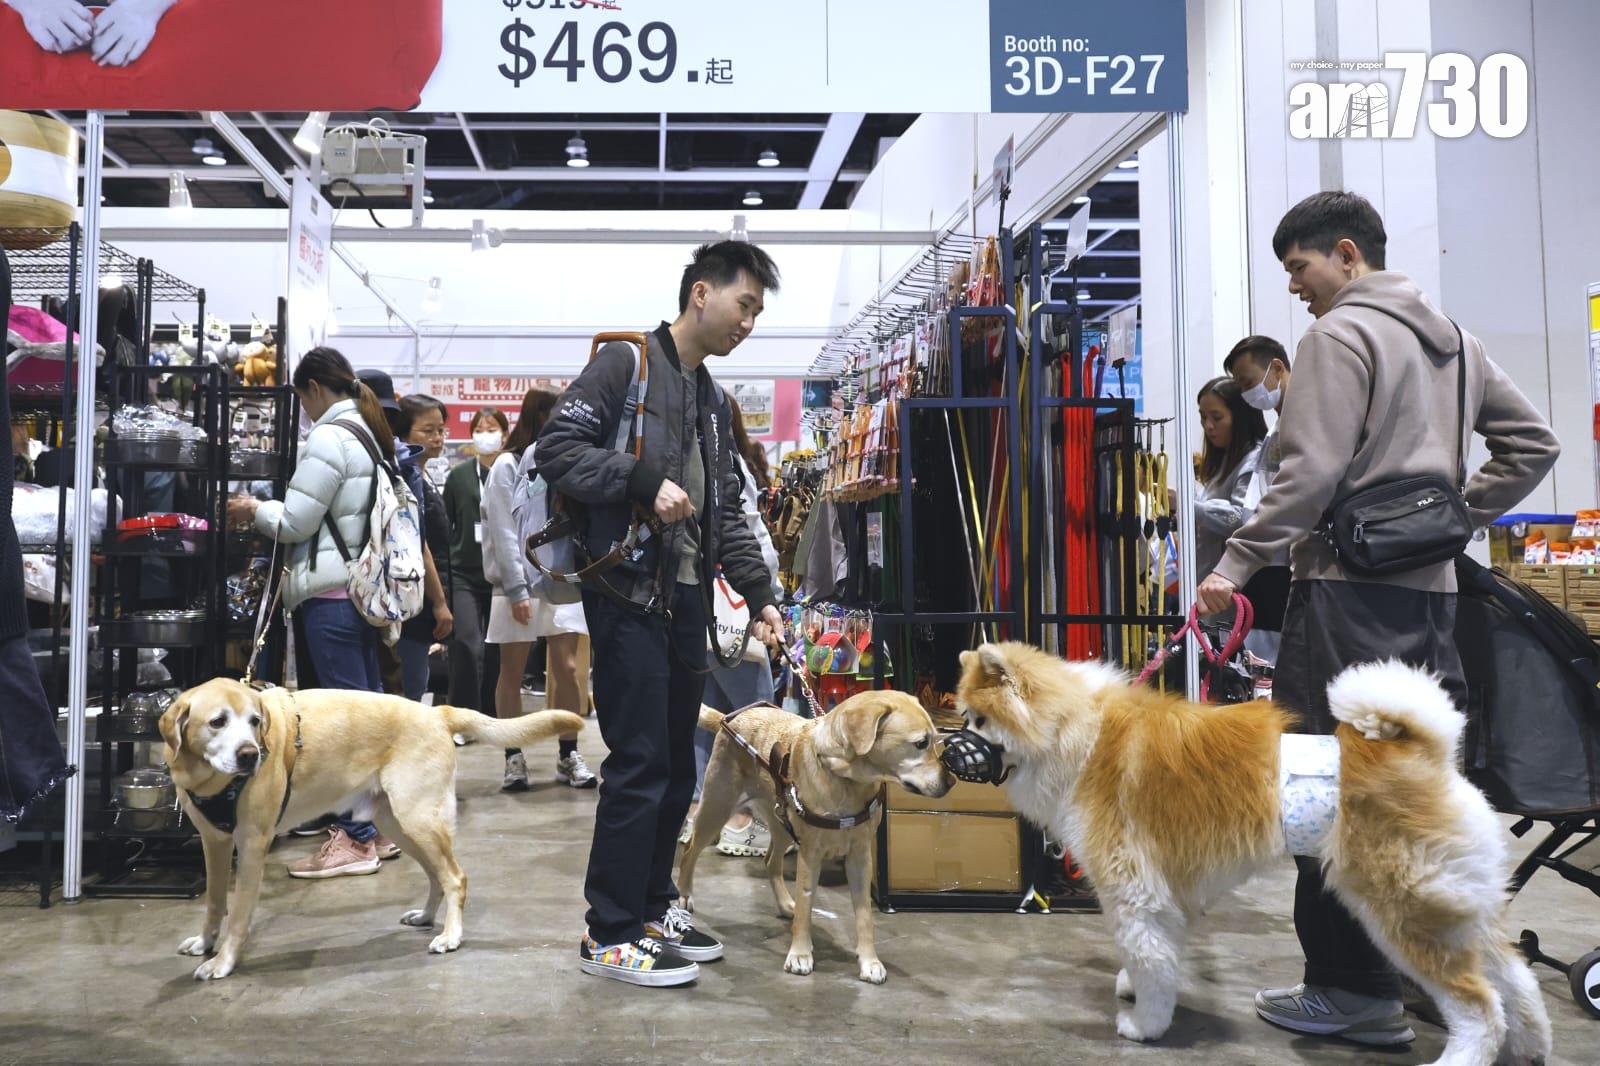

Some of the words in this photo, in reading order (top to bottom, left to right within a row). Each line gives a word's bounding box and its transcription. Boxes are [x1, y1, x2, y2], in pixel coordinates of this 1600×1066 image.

[1004, 35, 1057, 53] Booth
[1062, 38, 1089, 53] no:
[1004, 54, 1165, 96] 3D-F27
